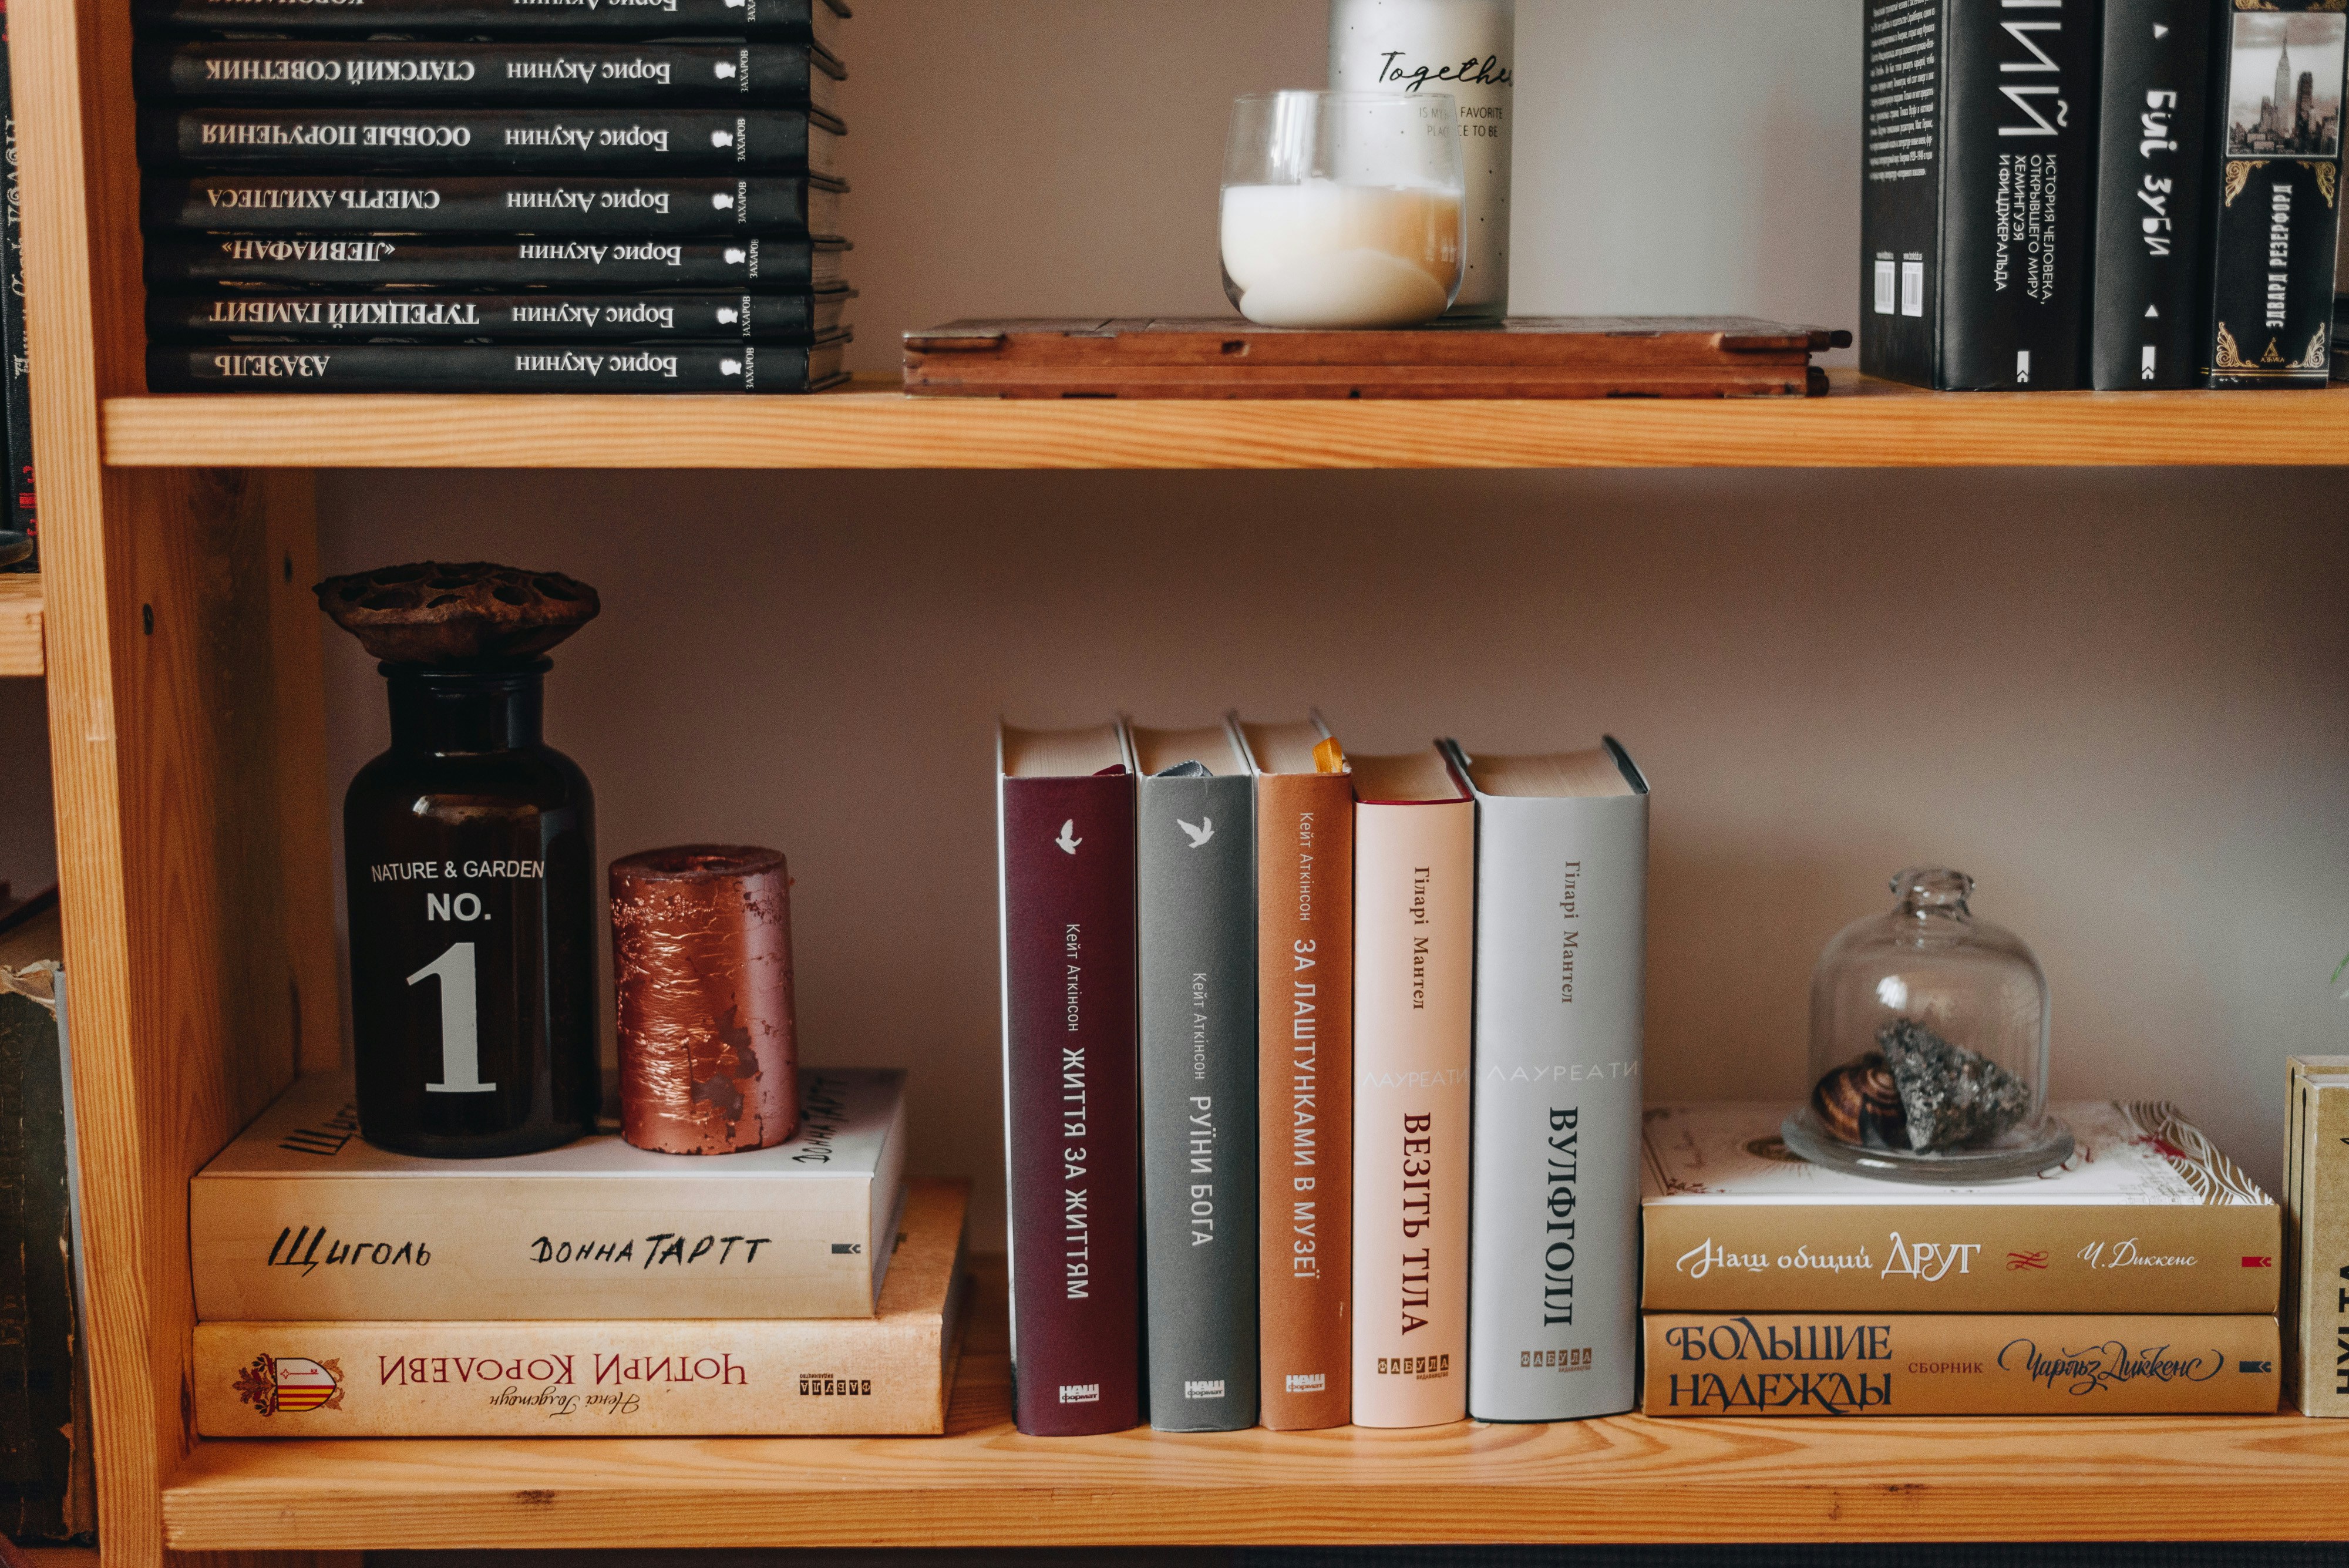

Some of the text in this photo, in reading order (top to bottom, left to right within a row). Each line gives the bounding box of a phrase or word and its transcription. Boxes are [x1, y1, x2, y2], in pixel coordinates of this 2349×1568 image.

[207, 61, 475, 85] СТАТСКИЙ СОВЕТНИК
[507, 59, 670, 84] Борис Акунин
[740, 49, 749, 92] ЗАХАРОВ
[1419, 107, 1428, 118] IS
[1460, 107, 1503, 119] FAVORITE
[203, 125, 470, 146] ОСОБЫЕ ПОРУЧЕНИЯ
[506, 126, 668, 152] Борис Акунин
[737, 118, 746, 161] ЗАХАРОВ
[1472, 125, 1486, 137] TO
[1488, 125, 1499, 137] BE
[208, 190, 440, 209] СМЕРТЬ АХИЛЛЕСА
[507, 189, 669, 214] Борис Акунин
[738, 181, 746, 224] ЗАХАРОВ
[2013, 156, 2026, 240] ХЕМИНГУЭЯ
[1994, 154, 2010, 291] И ФИЦДЖЕРАЛЬДА
[2027, 154, 2042, 299] ОТКРЫВШЕГО МИРУ
[2040, 154, 2057, 304] ИСТОРИЯ ЧЕЛОВЕКА,
[223, 241, 396, 262] «ЛЕВИАФАН»
[520, 242, 681, 266] Борис Акунин
[749, 238, 759, 279] ЗАХАРОВ
[2266, 183, 2291, 328] ЭДВАРД РЕЗЕРФОРД
[210, 300, 479, 328] ТУРЕЦКИЙ ГАМБИТ
[513, 303, 674, 328] Борис Акунин
[742, 295, 751, 338] ЗАХАРОВ
[215, 355, 330, 376] АЗАЗЕЛЬ
[516, 352, 677, 377] Борис Акунин
[745, 347, 754, 389] ЗАХАРОВ
[372, 860, 544, 881] NATURE & GARDEN
[1299, 813, 1313, 921] Кейт Аткінсон
[427, 893, 491, 921] NO.
[1409, 867, 1429, 1009] Гіларі Мантел
[1560, 862, 1580, 1002] Гіларі Мантел
[1066, 924, 1081, 1031] Кейт Аткінсон
[406, 942, 496, 1092] 1
[1193, 973, 1207, 1079] Кейт Аткінсон
[1362, 1066, 1468, 1088] ЛАУРЕАТИ
[1486, 1060, 1638, 1082] ЛАУРЕАТИ
[1294, 940, 1320, 1277] ЗА ЛАШТУНКАМИ В МУЗЕЇ
[1063, 1048, 1089, 1298] ЖИТТЯ ЗА ЖИТТЯМ
[1189, 1096, 1216, 1246] РУЇНИ БОГА
[1402, 1112, 1431, 1335] ВЕЗІТЬ ТІЛА
[1544, 1106, 1578, 1327] ВУЛФГОЛЛ
[644, 1233, 770, 1270] ТАРТТ
[1676, 1237, 1769, 1278] Наш
[1777, 1245, 1872, 1273] общий
[1665, 1317, 1892, 1361] БОЛЬШИЕ
[1378, 1354, 1449, 1374] ФАБУЛА
[1520, 1347, 1592, 1367] ФАБУЛА
[1908, 1362, 1983, 1374] СБОРНИК
[799, 1379, 871, 1395] ФАБУЛА
[1059, 1384, 1099, 1395] НАШ
[1184, 1380, 1225, 1391] НАШ
[1285, 1374, 1325, 1385] НАШ
[1669, 1372, 1892, 1415] НАДЕЖДЫ
[1061, 1392, 1098, 1403] формат
